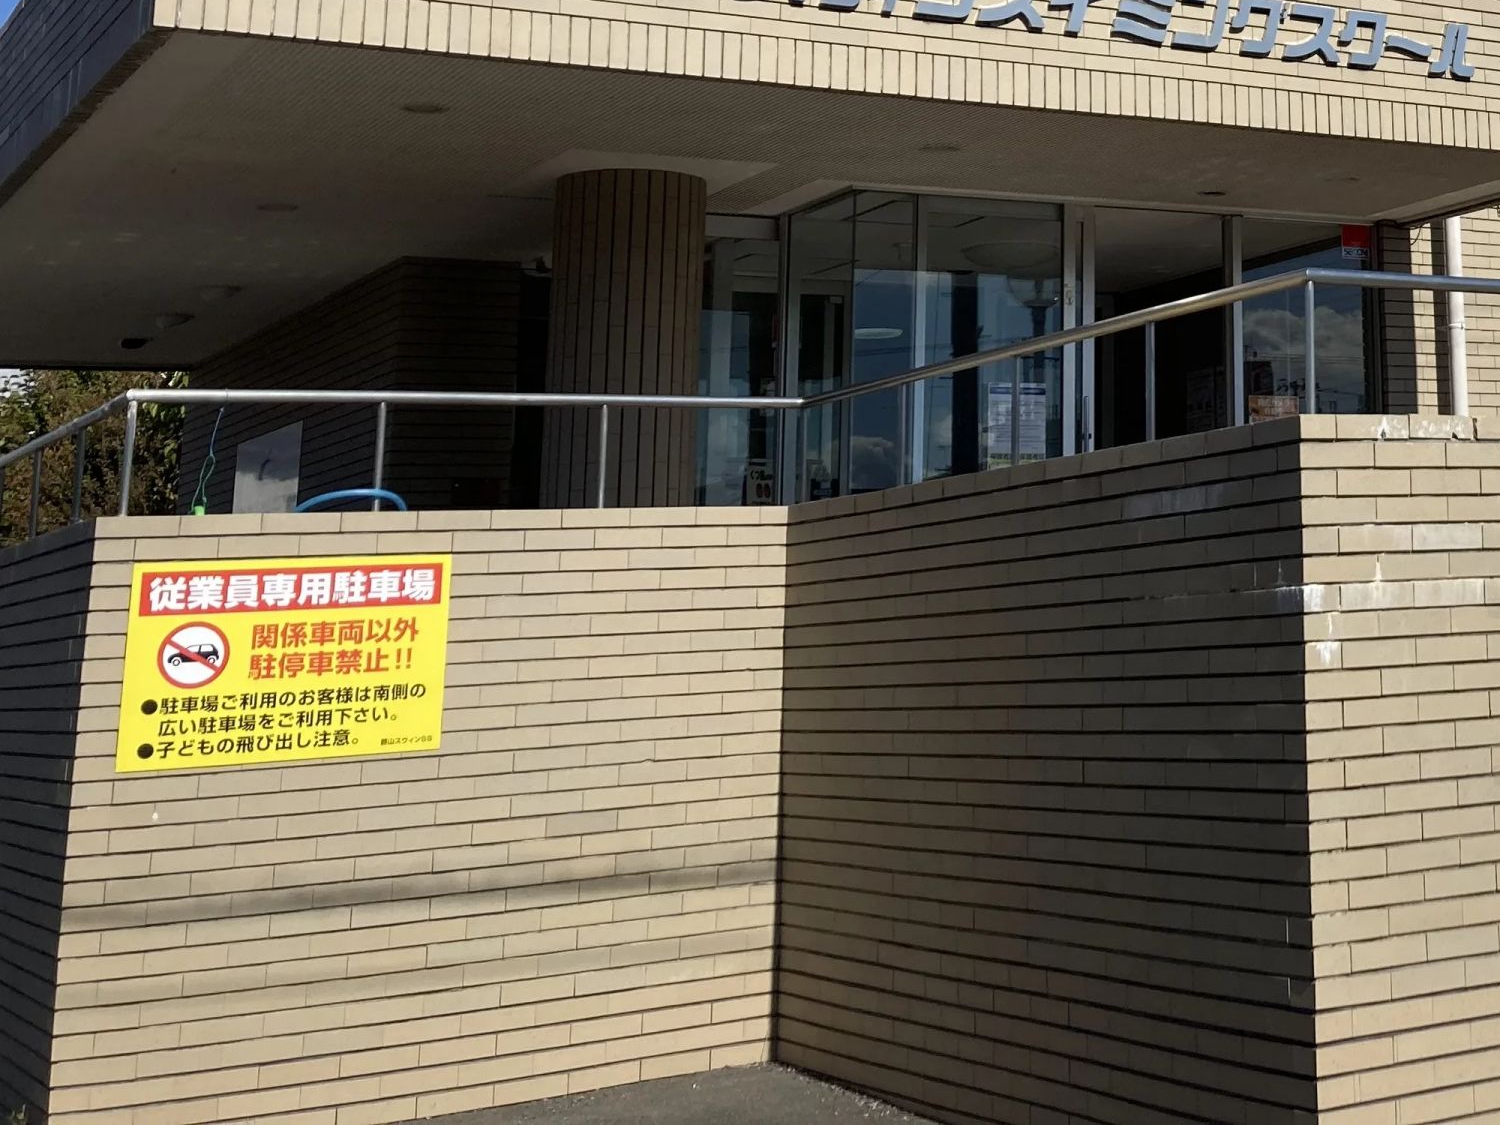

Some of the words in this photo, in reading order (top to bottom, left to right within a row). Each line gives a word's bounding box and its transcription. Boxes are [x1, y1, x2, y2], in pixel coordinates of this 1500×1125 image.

[149, 568, 436, 612] 従業員専用駐車場
[250, 616, 419, 651] 関係車両以外
[247, 647, 412, 681] 駐停車禁止!!
[158, 707, 398, 737] 広い駐車場をご利用下さい。
[156, 729, 359, 759] 子どもの飛び出し注意。
